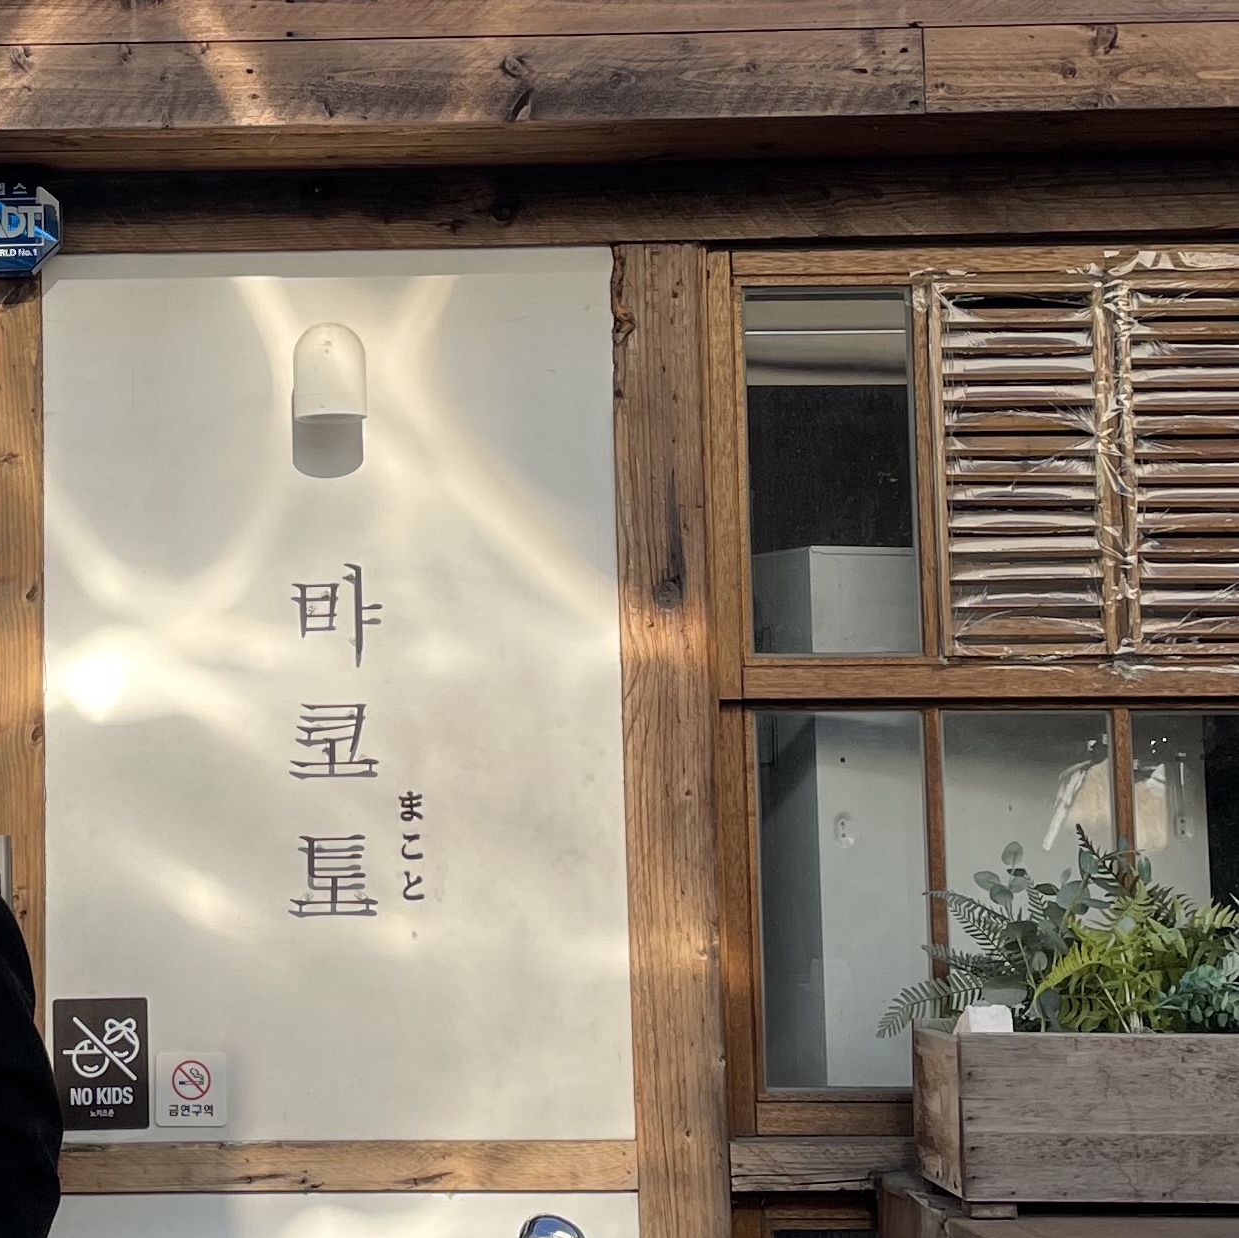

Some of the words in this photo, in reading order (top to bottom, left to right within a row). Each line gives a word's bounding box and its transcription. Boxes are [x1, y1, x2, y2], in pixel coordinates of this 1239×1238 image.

[18, 248, 38, 257] No.1
[398, 791, 425, 901] まこと
[70, 1087, 93, 1106] NO
[96, 1086, 134, 1105] KIDS
[168, 1104, 214, 1117] 금연구역
